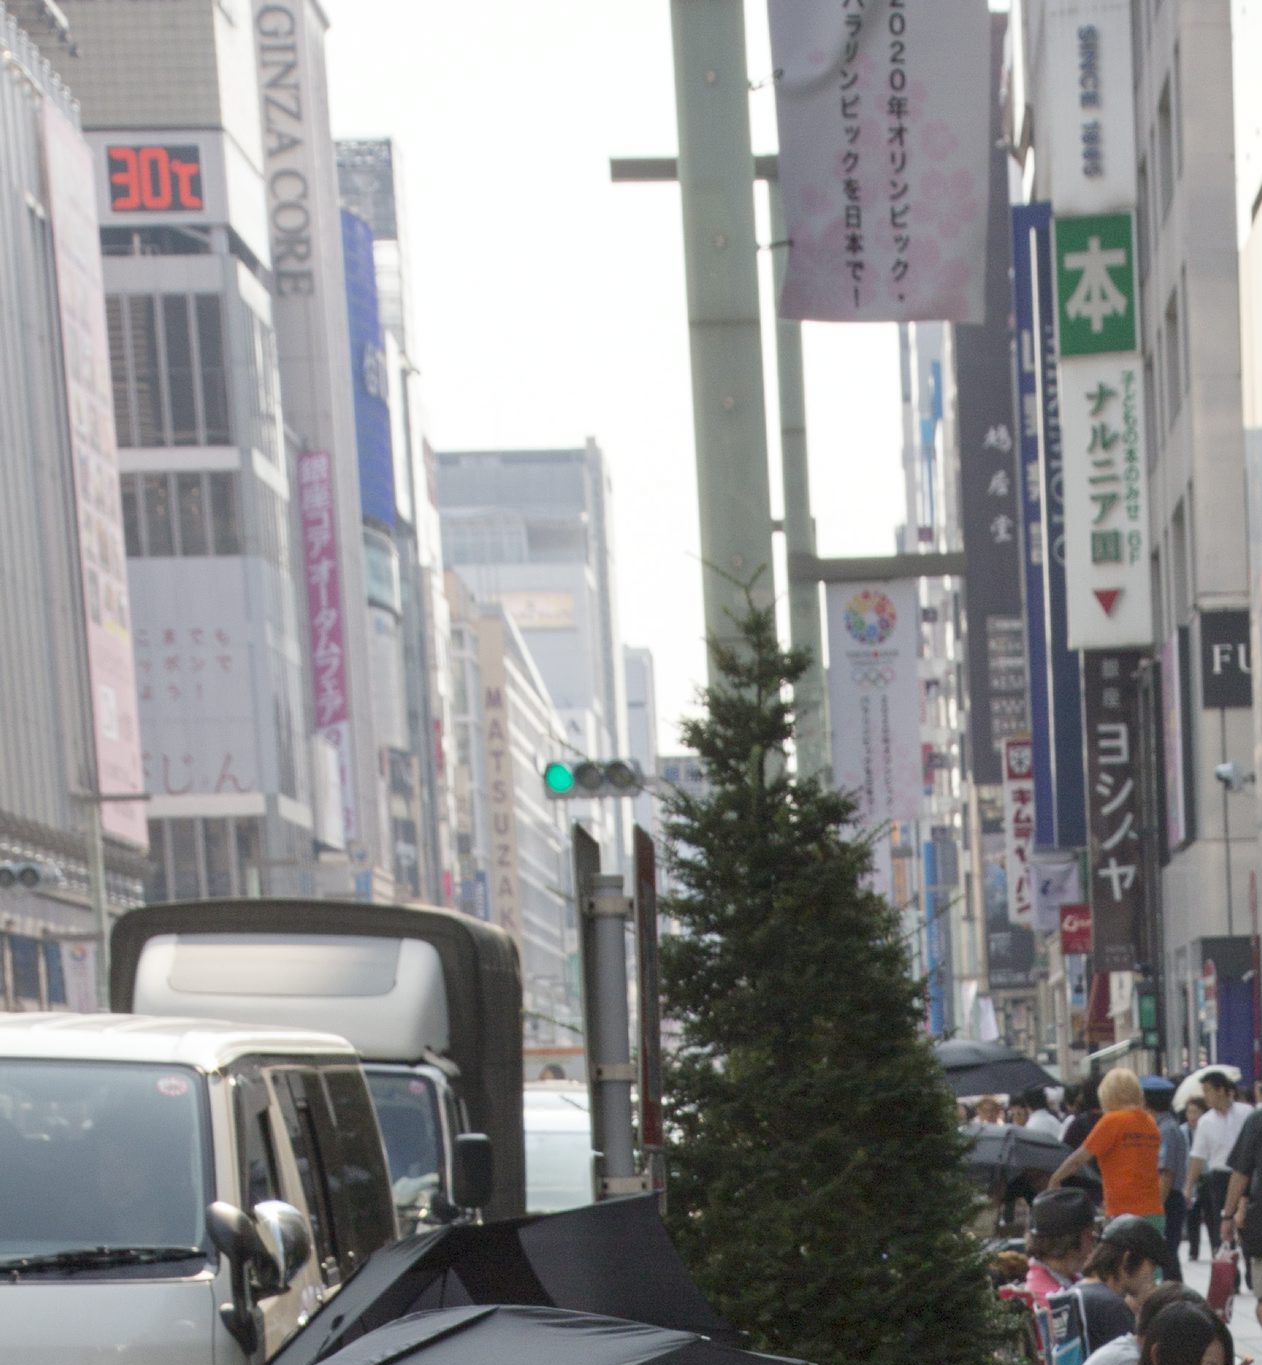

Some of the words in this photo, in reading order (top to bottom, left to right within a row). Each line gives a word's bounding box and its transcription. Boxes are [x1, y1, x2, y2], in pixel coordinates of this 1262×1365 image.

[257, 6, 304, 159] GINZA
[269, 168, 315, 298] CORE
[1064, 236, 1128, 333] 本
[1086, 381, 1123, 562] ナルニア国
